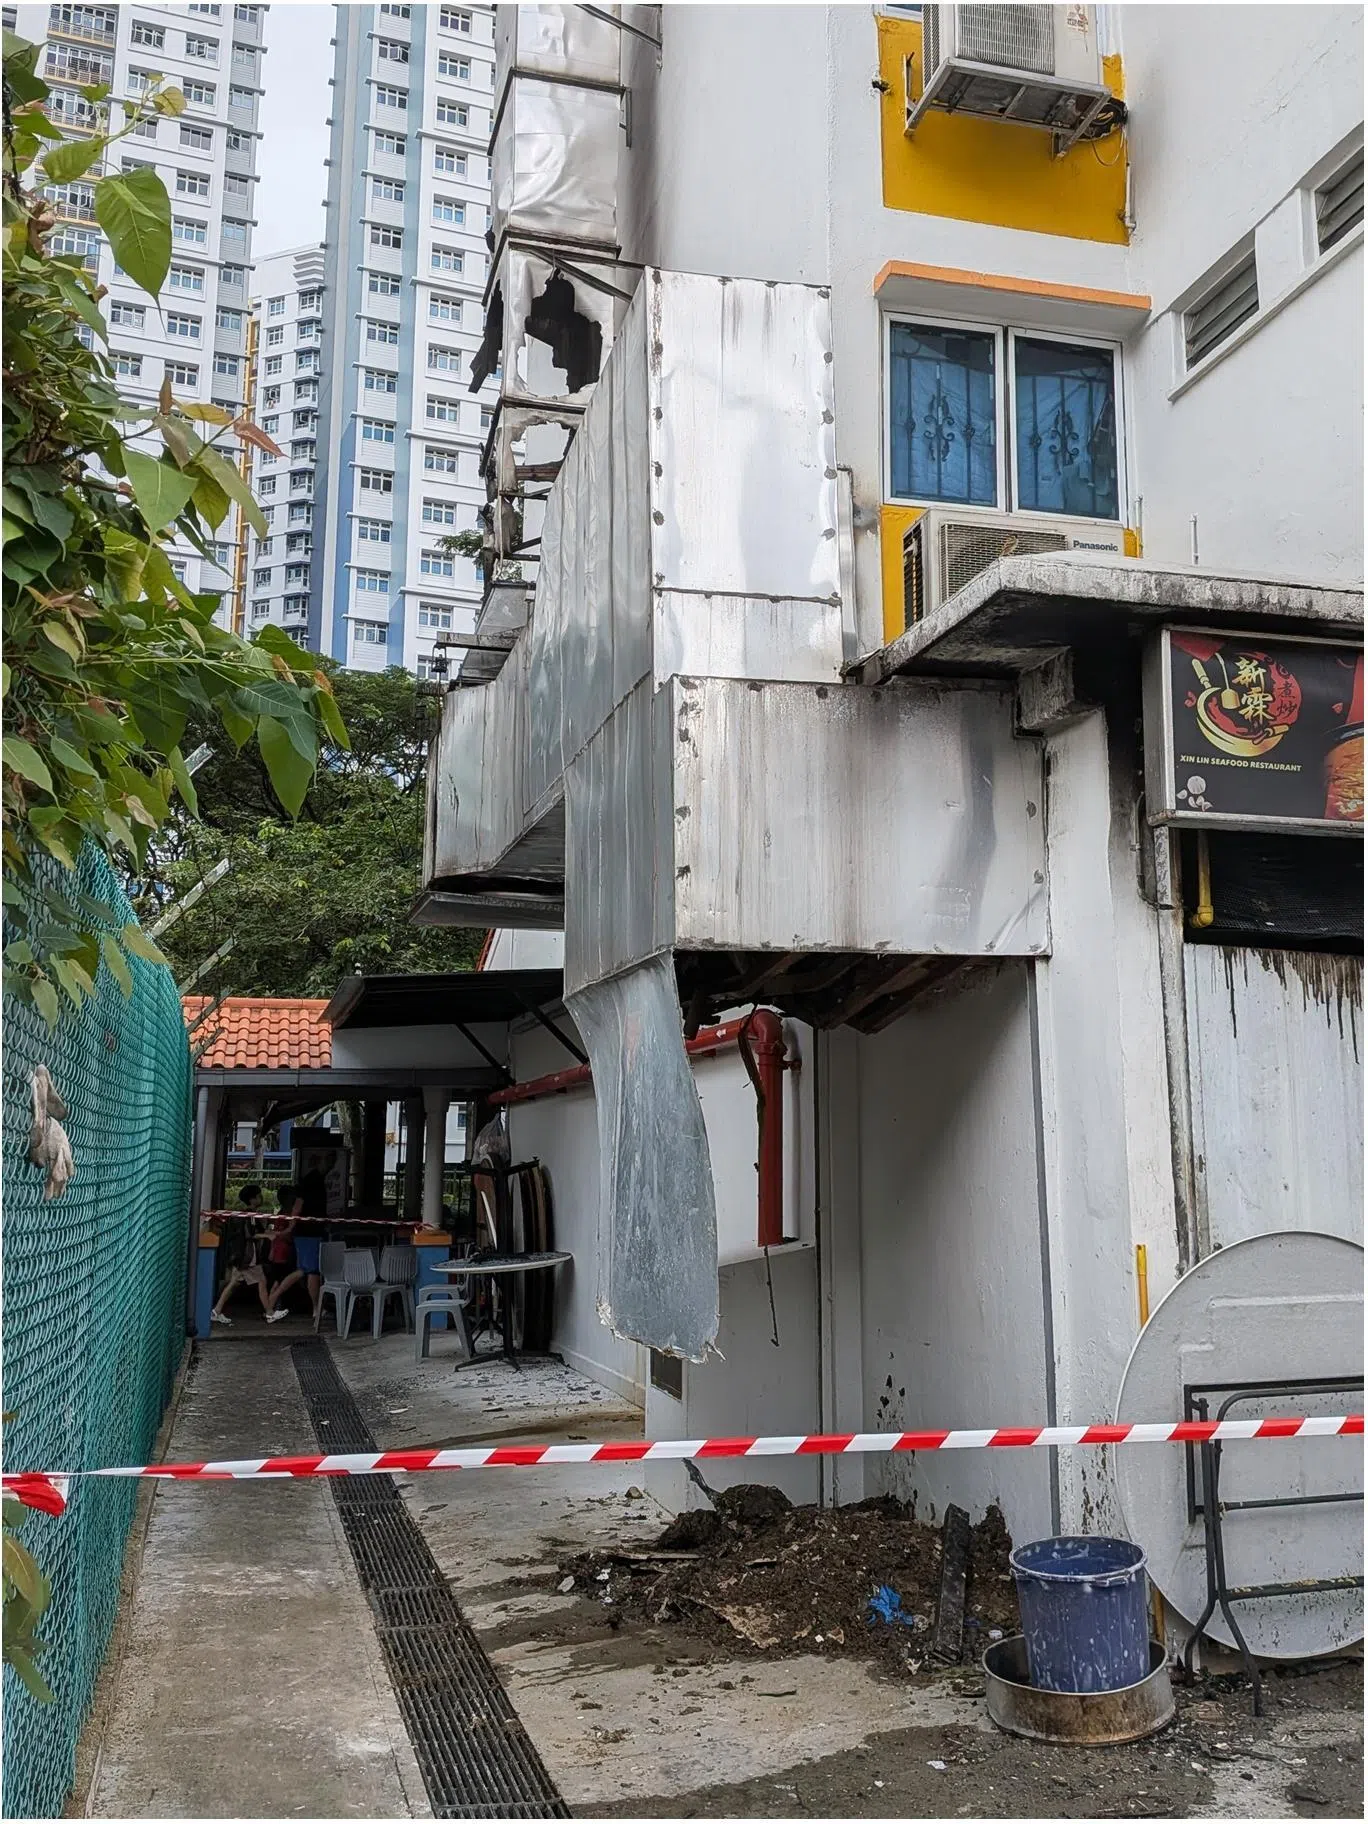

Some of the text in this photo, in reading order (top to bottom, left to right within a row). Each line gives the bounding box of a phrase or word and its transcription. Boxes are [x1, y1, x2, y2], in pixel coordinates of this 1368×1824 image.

[1073, 540, 1119, 551] Panasonic
[1180, 755, 1302, 772] XIN LIN SEAFOOD RESTAURANT
